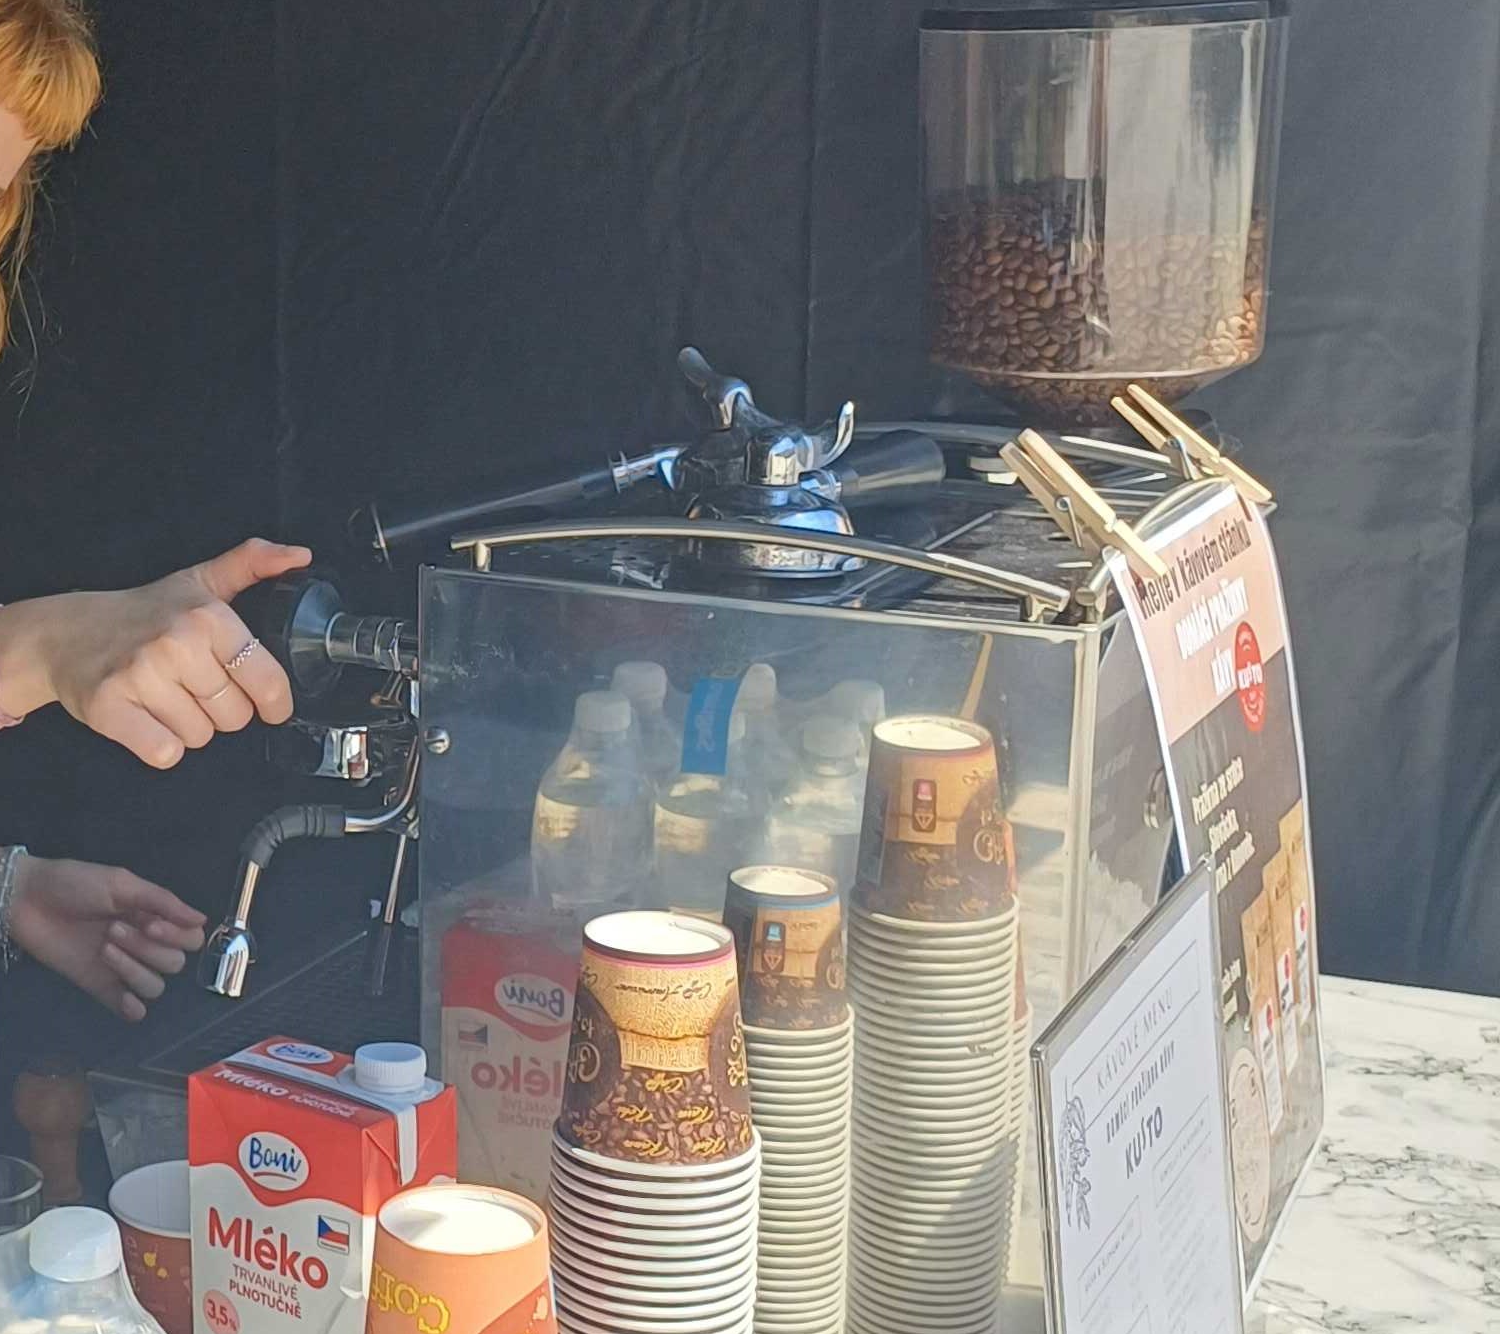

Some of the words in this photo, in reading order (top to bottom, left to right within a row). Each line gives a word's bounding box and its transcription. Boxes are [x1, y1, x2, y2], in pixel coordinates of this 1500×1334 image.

[213, 1067, 289, 1097] Mléko
[249, 1136, 302, 1174] Boni
[1124, 1105, 1163, 1180] KUSTO
[208, 1207, 329, 1289] Mléko
[229, 1278, 302, 1319] PLNOTUČNÉ
[232, 1263, 299, 1301] TRVANLIVÉ
